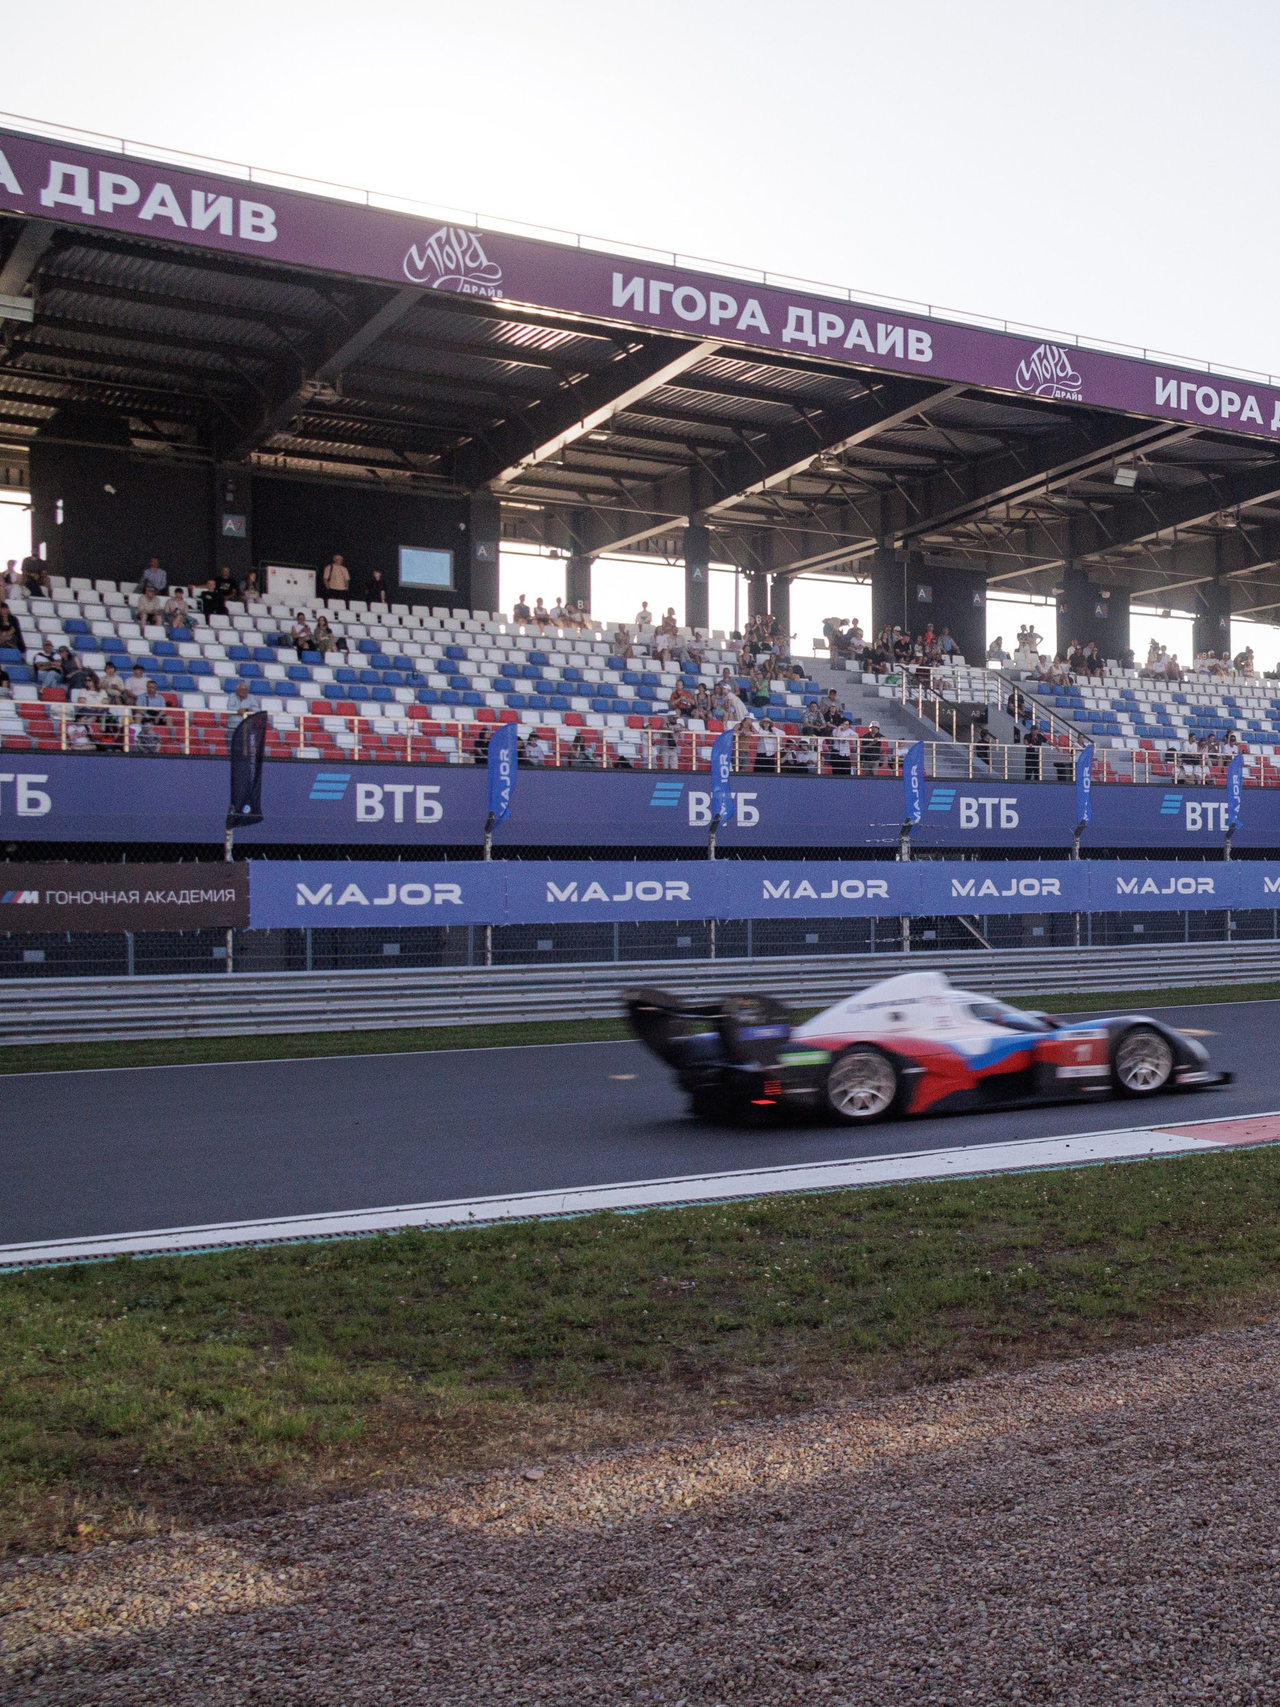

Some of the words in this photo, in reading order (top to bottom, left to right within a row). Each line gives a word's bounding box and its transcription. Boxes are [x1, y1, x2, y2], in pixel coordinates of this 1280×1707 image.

[40, 160, 278, 243] ДРАЙВ
[462, 283, 503, 299] ДРАЙВ
[612, 272, 770, 334] ИГОРА
[782, 306, 933, 363] ДРАЙВ
[1055, 390, 1083, 402] ДРАЙВ
[1155, 376, 1263, 425] ИГОРА
[356, 783, 443, 824] ВТБ
[688, 791, 760, 827] ВБ
[960, 797, 1019, 830] ВТБ
[45, 890, 139, 905] ГОНОЧНАЯ
[144, 889, 235, 905] АКАДЕМИЯ
[296, 883, 464, 906] MAJOR
[546, 880, 691, 903] MAJOR
[762, 879, 890, 899] MAJOR
[951, 878, 1061, 897] MAJOR
[1116, 877, 1216, 895] MAJOR
[1073, 1044, 1092, 1062] 1
